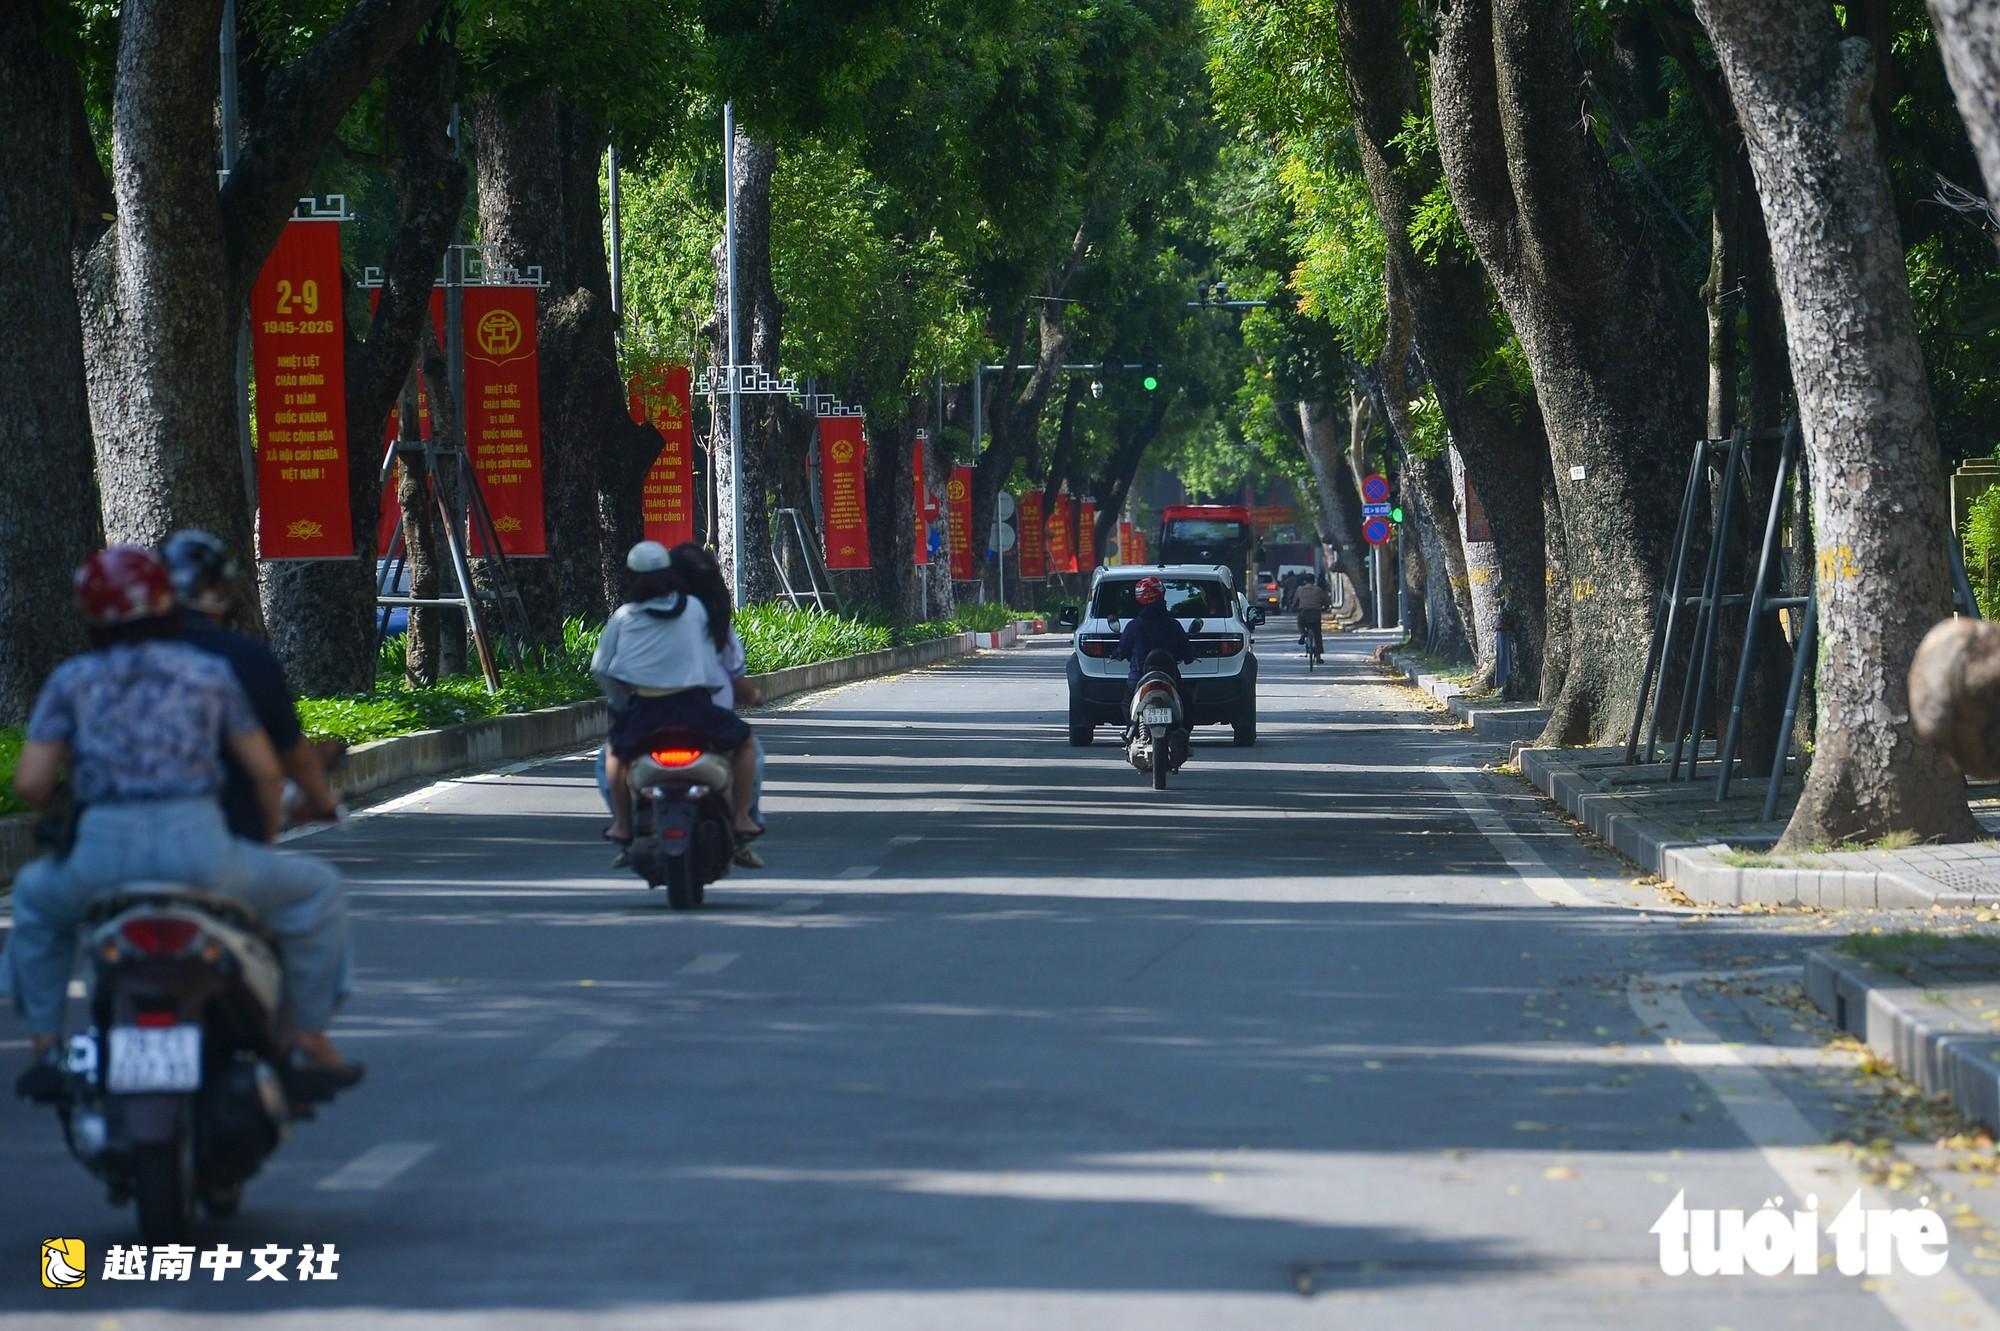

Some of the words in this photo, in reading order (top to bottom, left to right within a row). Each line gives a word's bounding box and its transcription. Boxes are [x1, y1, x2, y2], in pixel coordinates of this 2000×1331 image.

[277, 280, 318, 314] 2-9
[262, 320, 334, 334] 1945-2026
[303, 354, 320, 369] LIỆT
[275, 372, 297, 386] CHÀO
[296, 392, 316, 405] NĂM
[275, 409, 297, 424] QUỐC
[299, 410, 327, 424] KHÁNH
[293, 429, 316, 444] CỘNG
[281, 467, 299, 482] VIỆT
[300, 468, 319, 480] NAM
